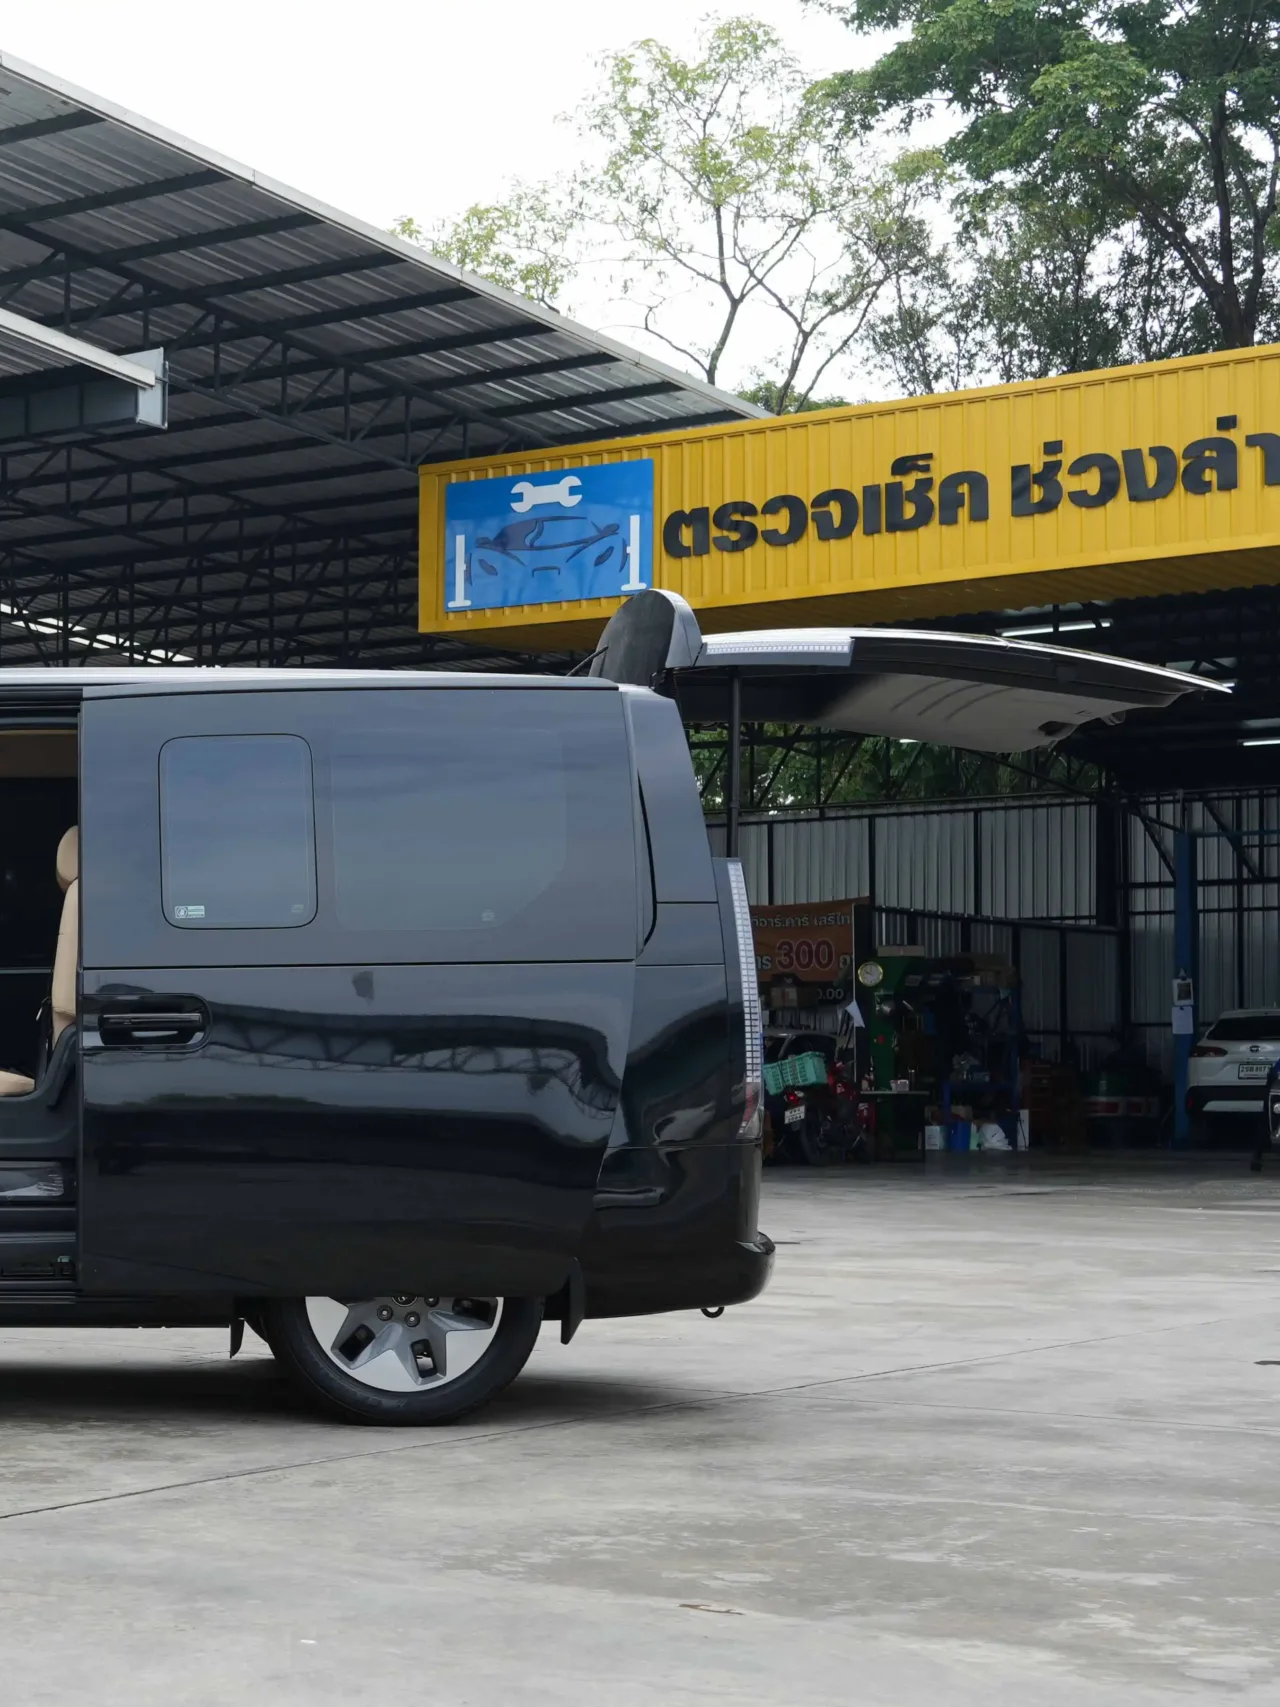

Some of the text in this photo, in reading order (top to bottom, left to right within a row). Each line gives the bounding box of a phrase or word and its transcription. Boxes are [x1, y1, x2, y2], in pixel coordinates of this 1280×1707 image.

[663, 453, 989, 558] ตรวจเช็ค
[776, 938, 835, 971] 300
